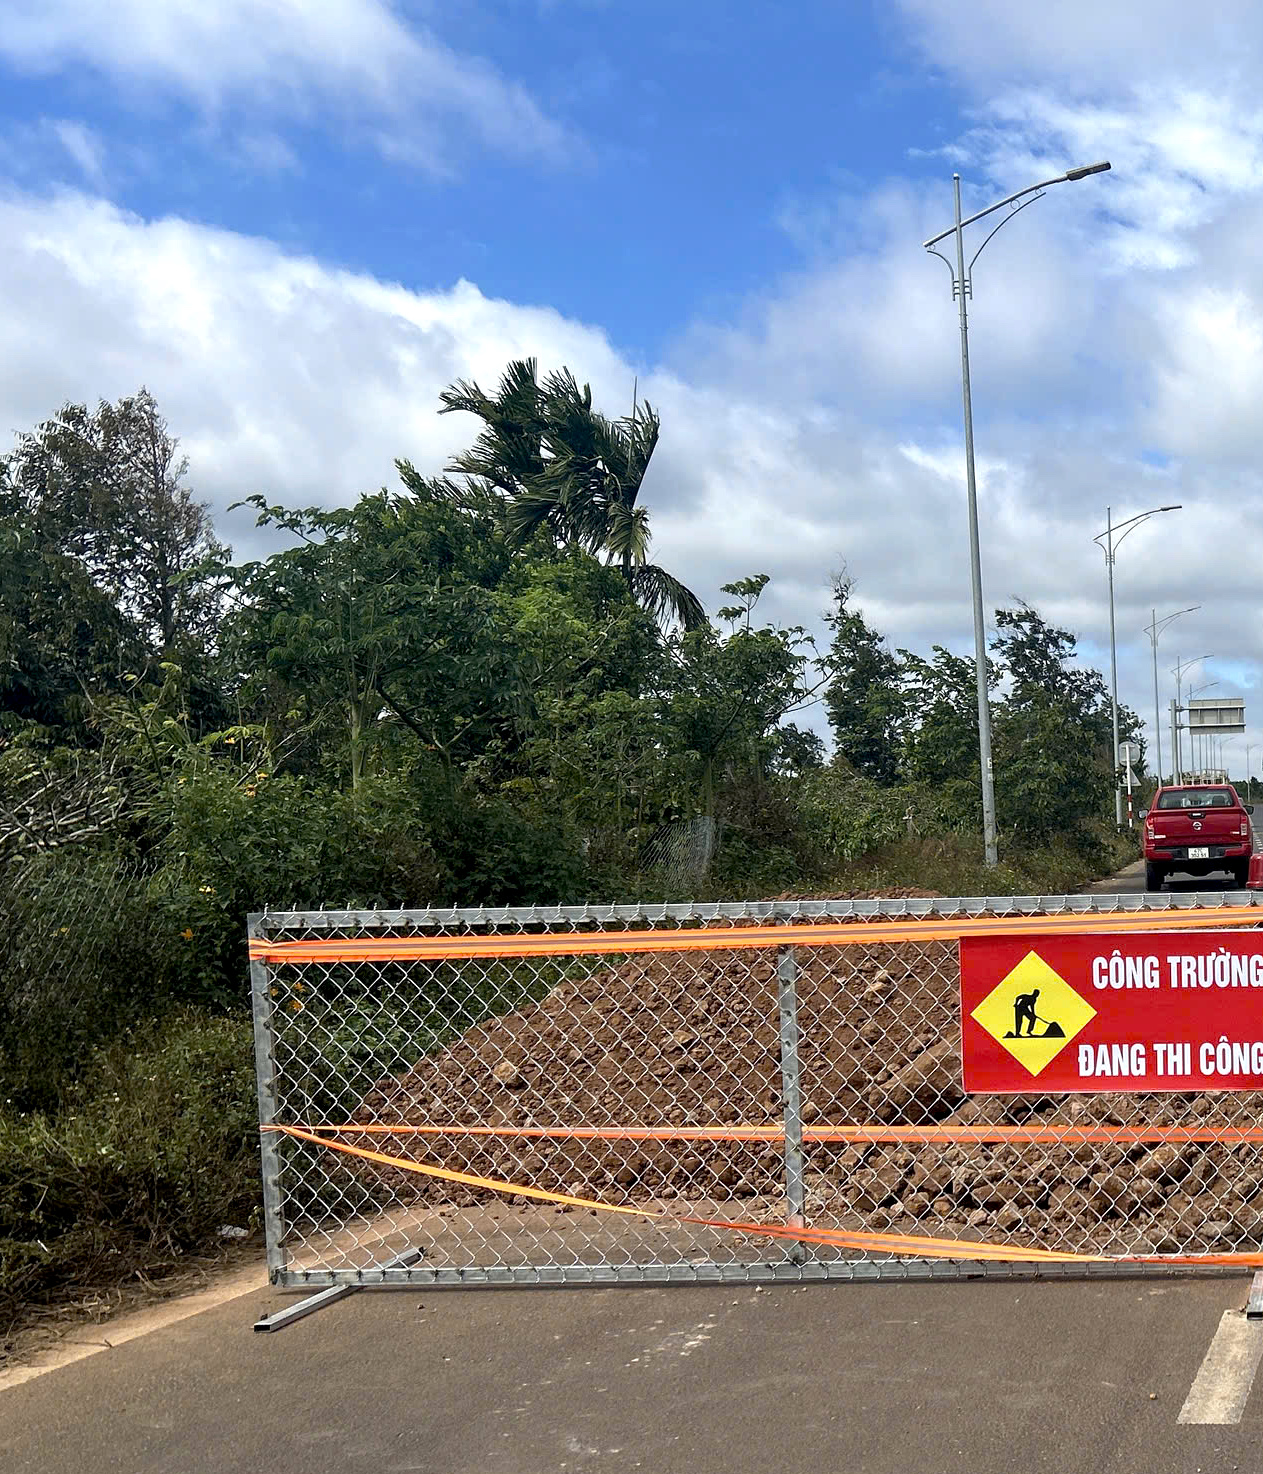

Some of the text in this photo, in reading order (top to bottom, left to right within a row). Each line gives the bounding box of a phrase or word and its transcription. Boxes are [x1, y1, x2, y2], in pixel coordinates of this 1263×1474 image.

[1092, 949, 1160, 990] CÔNG
[1077, 1042, 1147, 1078] ĐANG
[1153, 1042, 1192, 1077] THI
